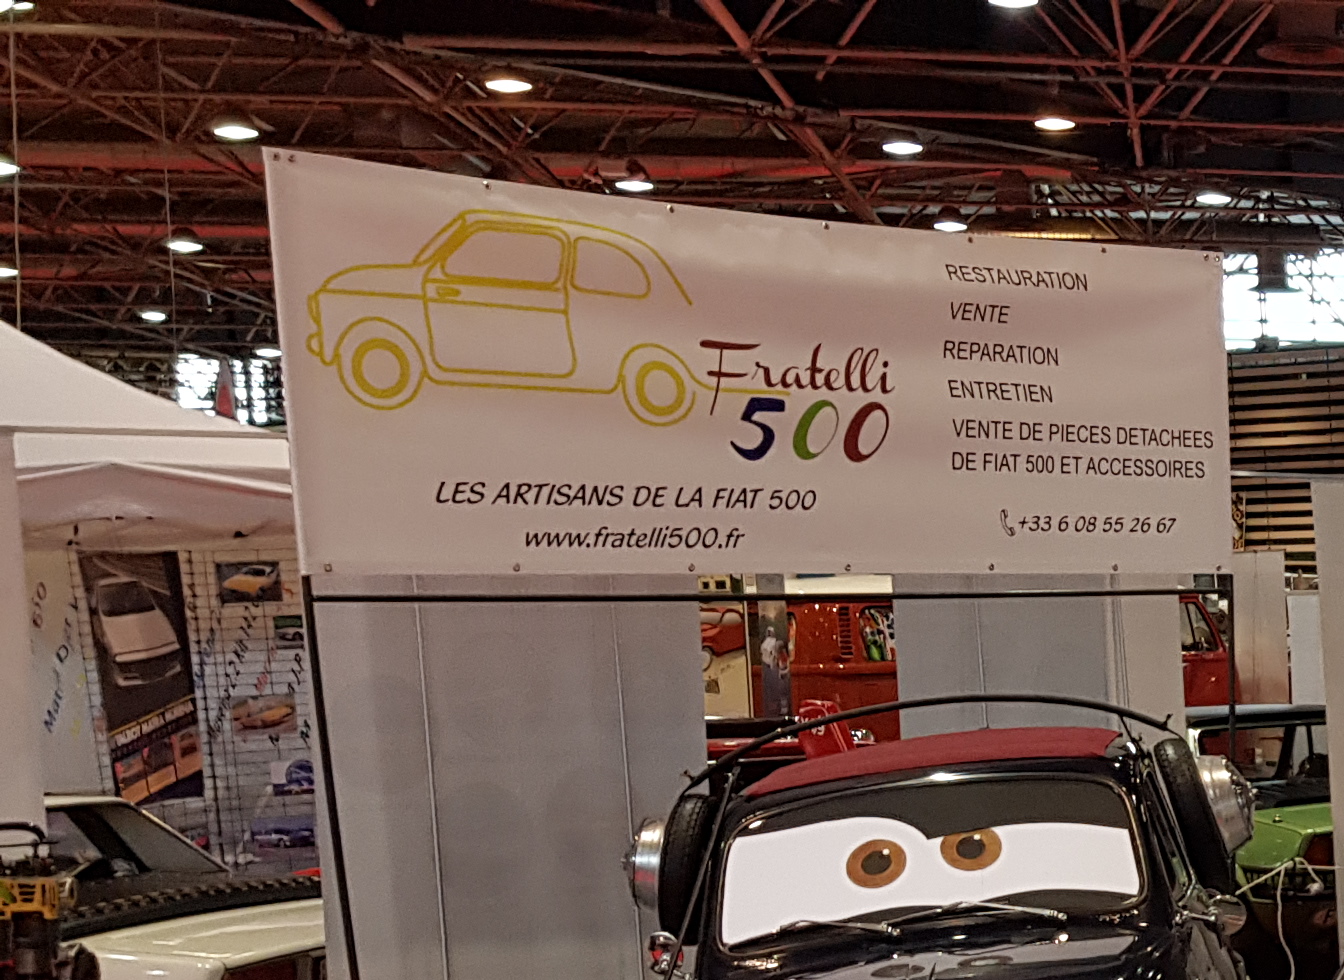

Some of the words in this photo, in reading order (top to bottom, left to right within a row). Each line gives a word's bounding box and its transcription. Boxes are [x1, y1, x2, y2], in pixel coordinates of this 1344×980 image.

[945, 264, 1088, 291] RESTAURATION
[950, 302, 1010, 323] VENTE
[943, 340, 1059, 366] REPARATION
[700, 339, 895, 416] Fratelli
[948, 379, 1053, 404] ENTRETIEN
[730, 397, 890, 462] 500
[952, 418, 1013, 440] VENTE
[1019, 421, 1043, 441] DE
[1049, 423, 1111, 444] PIECES
[1117, 427, 1214, 449] DETACHEES
[952, 452, 977, 471] DE
[983, 453, 1021, 472] FIAT
[1025, 455, 1054, 474] 500
[1060, 456, 1083, 474] ET
[1086, 457, 1205, 478] ACCESSOIRES
[436, 481, 486, 504] LES
[491, 482, 624, 506] ARTISANS
[632, 485, 667, 508] DE
[674, 486, 703, 509] LA
[713, 488, 764, 510] FIAT
[768, 489, 817, 511] 500
[1018, 515, 1051, 532] +33
[1058, 515, 1069, 532] 6
[1074, 516, 1097, 532] 08
[1102, 517, 1124, 533] 55
[1129, 516, 1152, 533] 26
[1156, 517, 1176, 533] 67
[525, 526, 745, 550] www.fratelli500.fr
